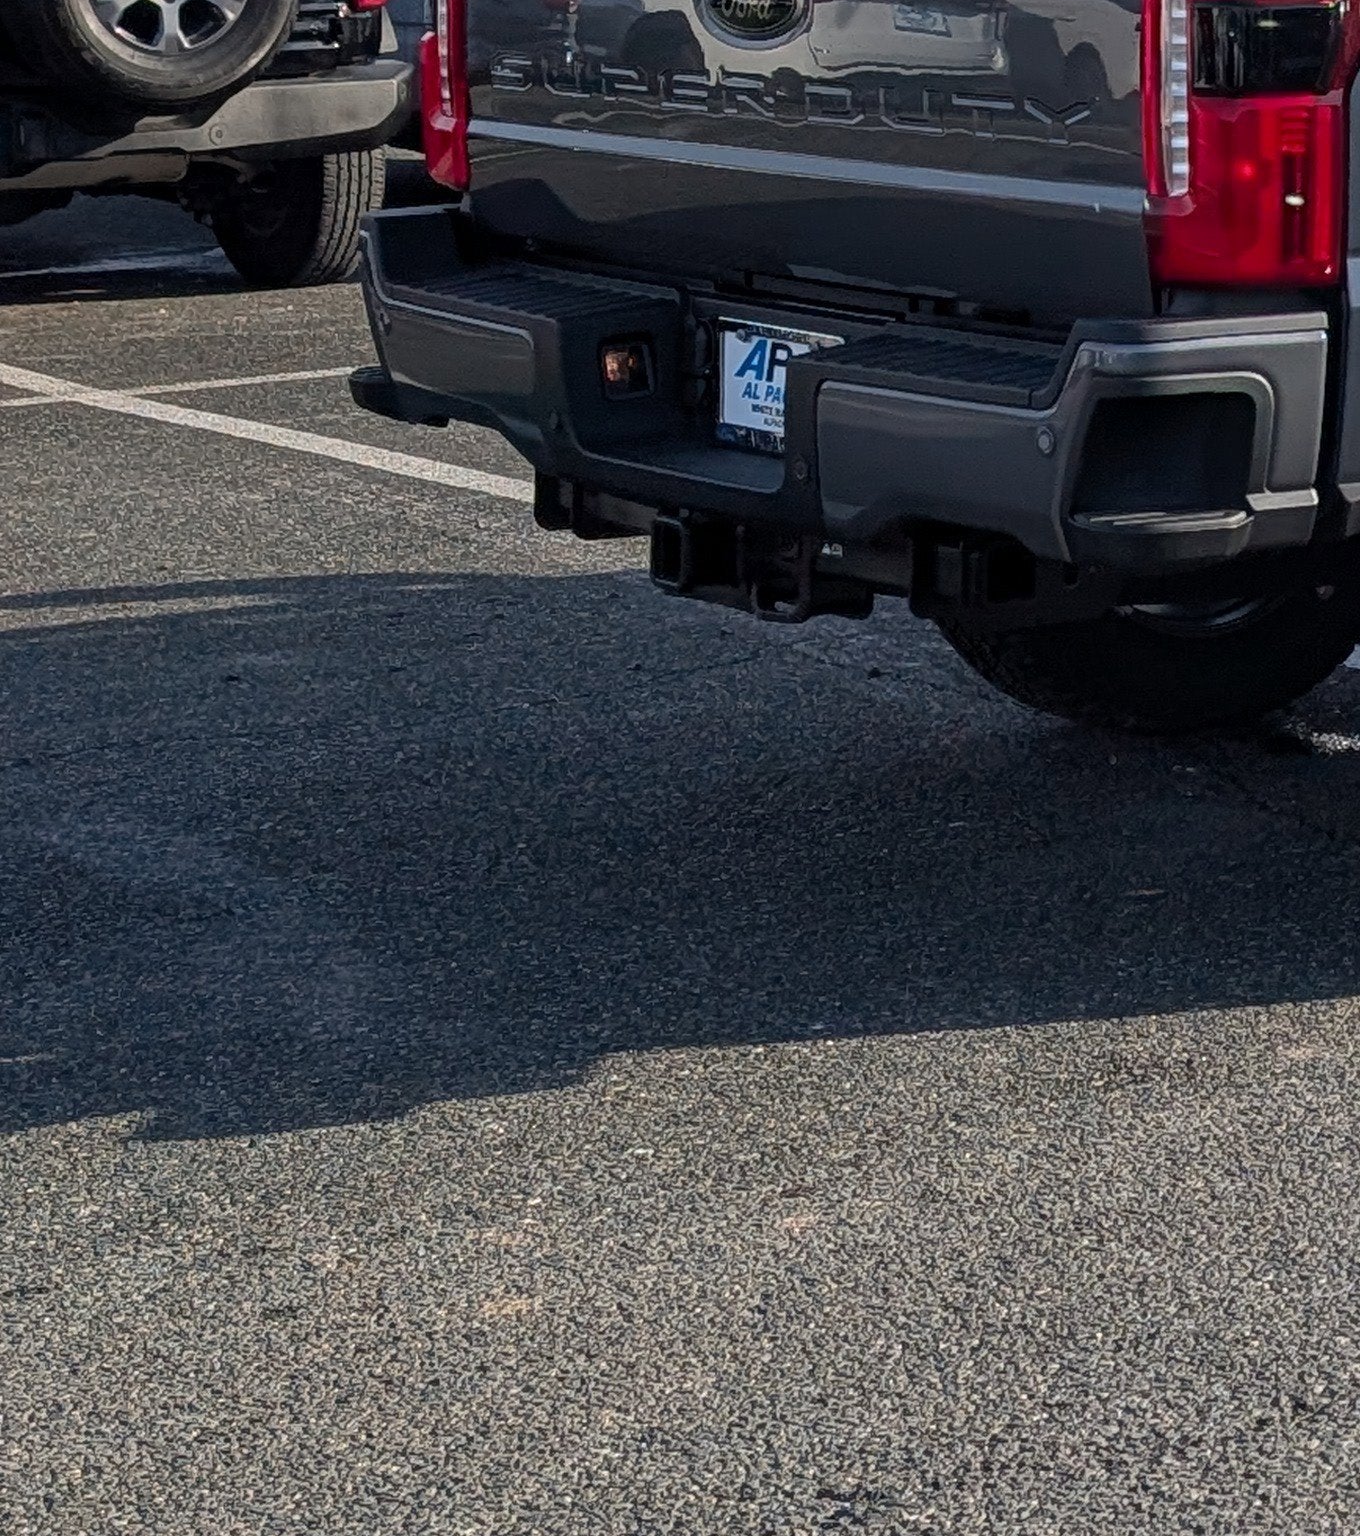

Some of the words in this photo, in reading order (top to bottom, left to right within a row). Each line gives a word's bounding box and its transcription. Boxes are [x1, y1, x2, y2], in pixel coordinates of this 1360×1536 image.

[490, 50, 778, 119] SUPER
[803, 82, 1098, 145] DUTY
[741, 381, 760, 400] AL
